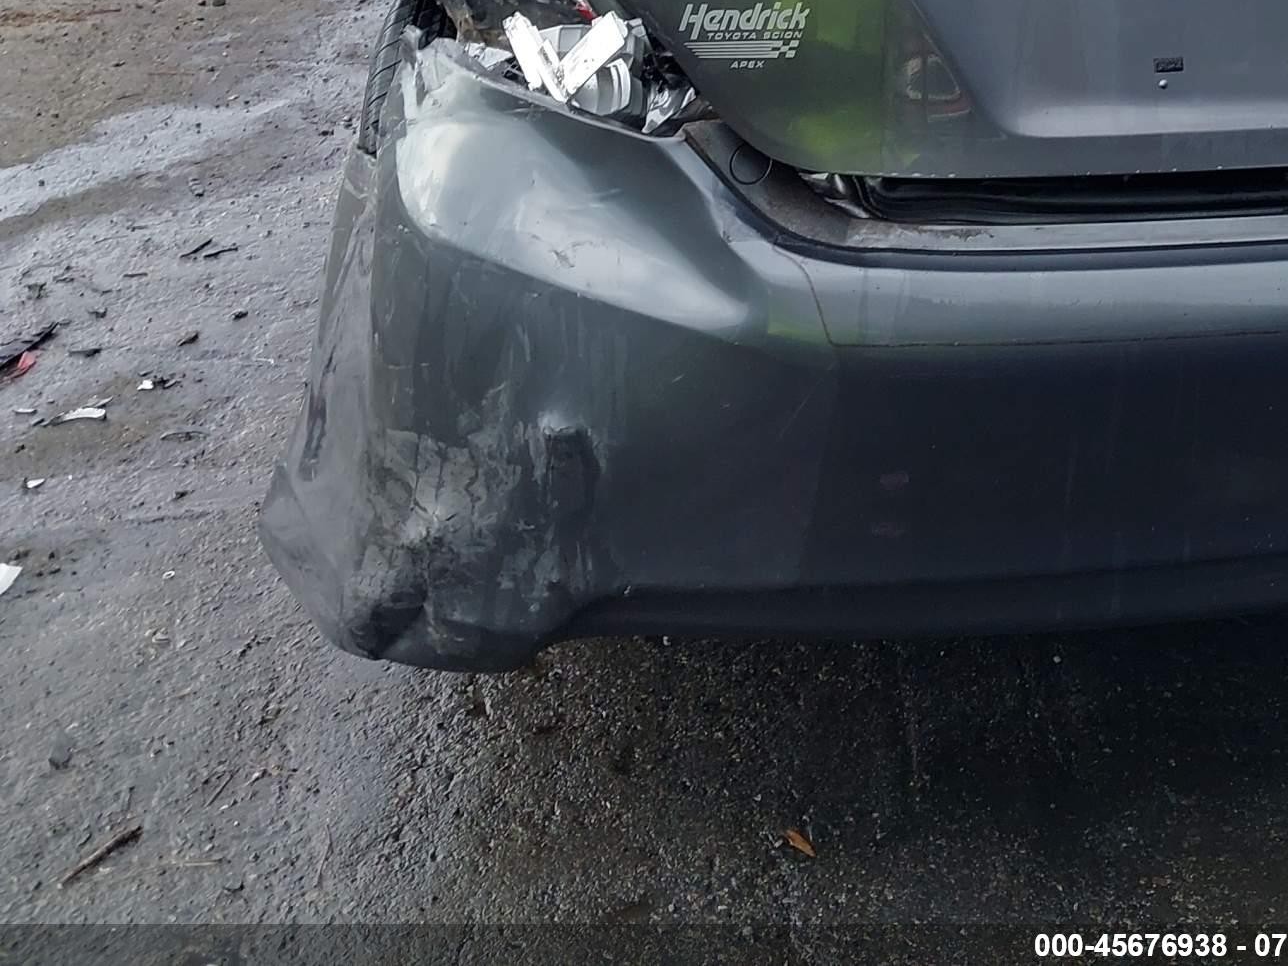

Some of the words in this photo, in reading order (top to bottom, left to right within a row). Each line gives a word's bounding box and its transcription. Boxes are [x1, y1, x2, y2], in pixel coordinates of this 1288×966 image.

[678, 1, 811, 41] Hendrick
[706, 31, 757, 40] TOYOTA
[763, 31, 803, 40] SCION
[730, 60, 766, 69] APEX
